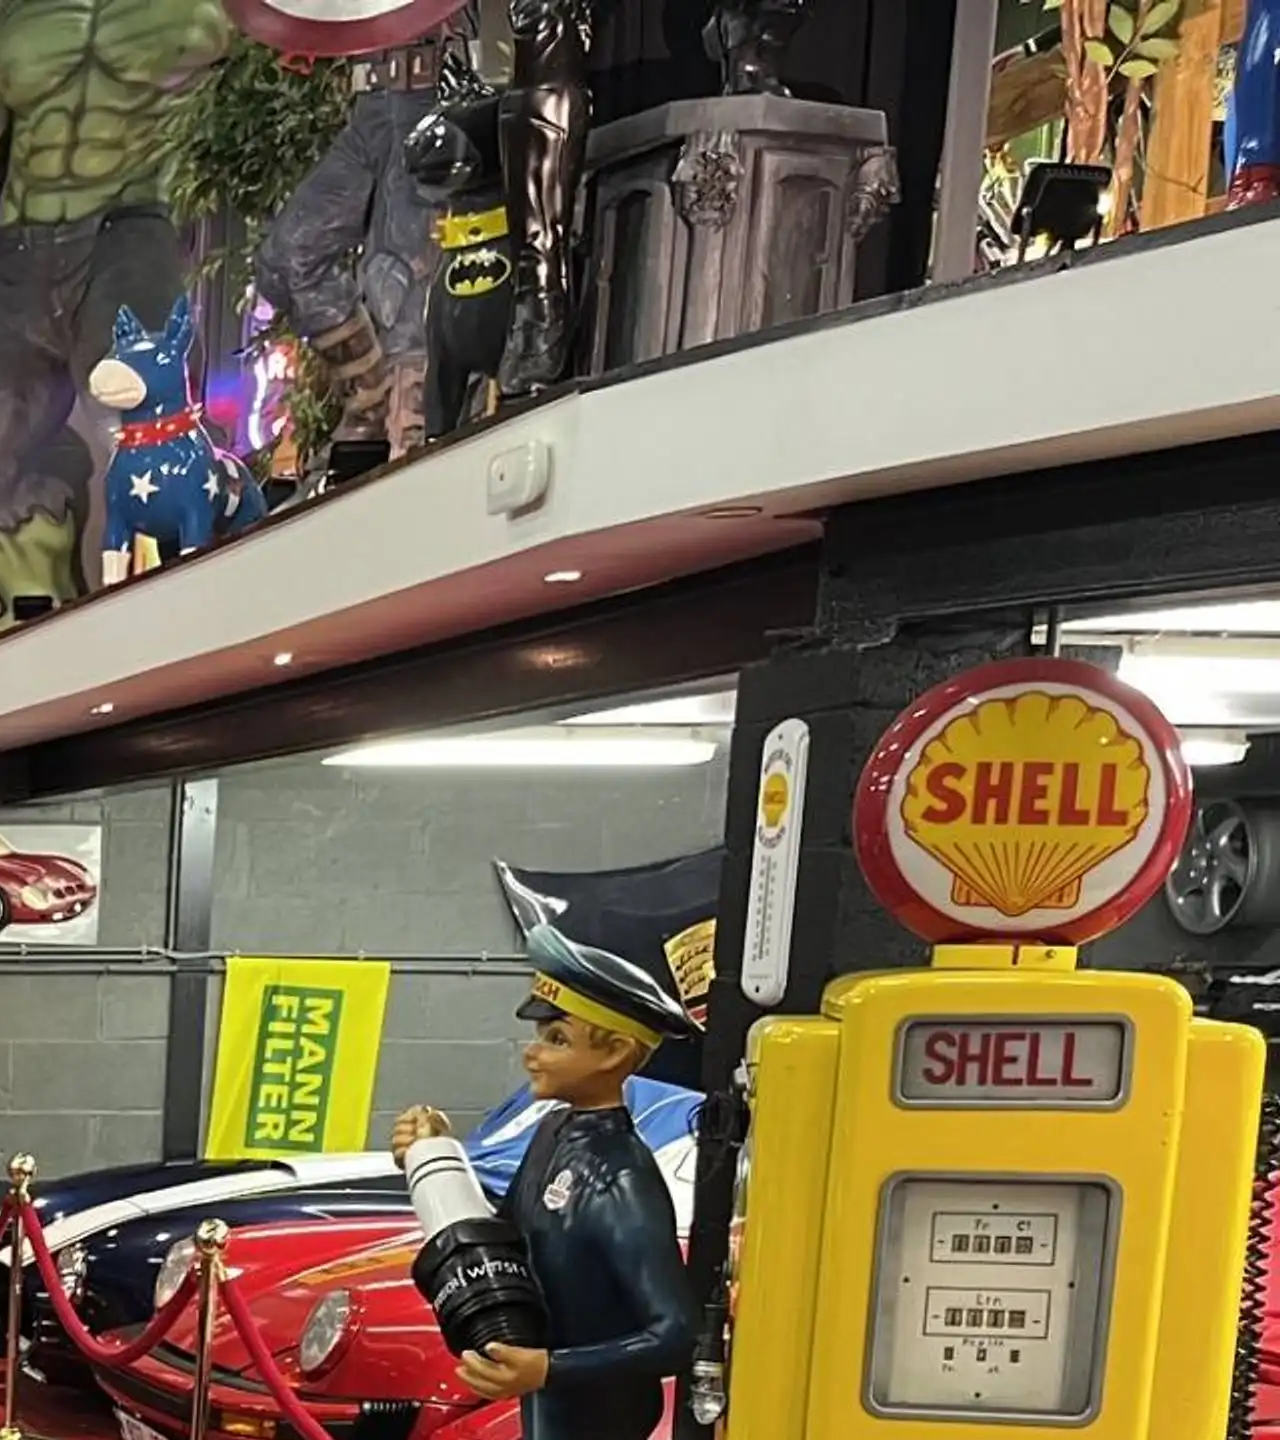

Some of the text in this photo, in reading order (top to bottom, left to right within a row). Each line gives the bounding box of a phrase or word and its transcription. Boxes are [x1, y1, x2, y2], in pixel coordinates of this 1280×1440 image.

[920, 761, 1129, 827] SHELL
[254, 994, 300, 1140] FILTER
[288, 998, 334, 1142] MANN
[921, 1031, 1094, 1088] SHELL
